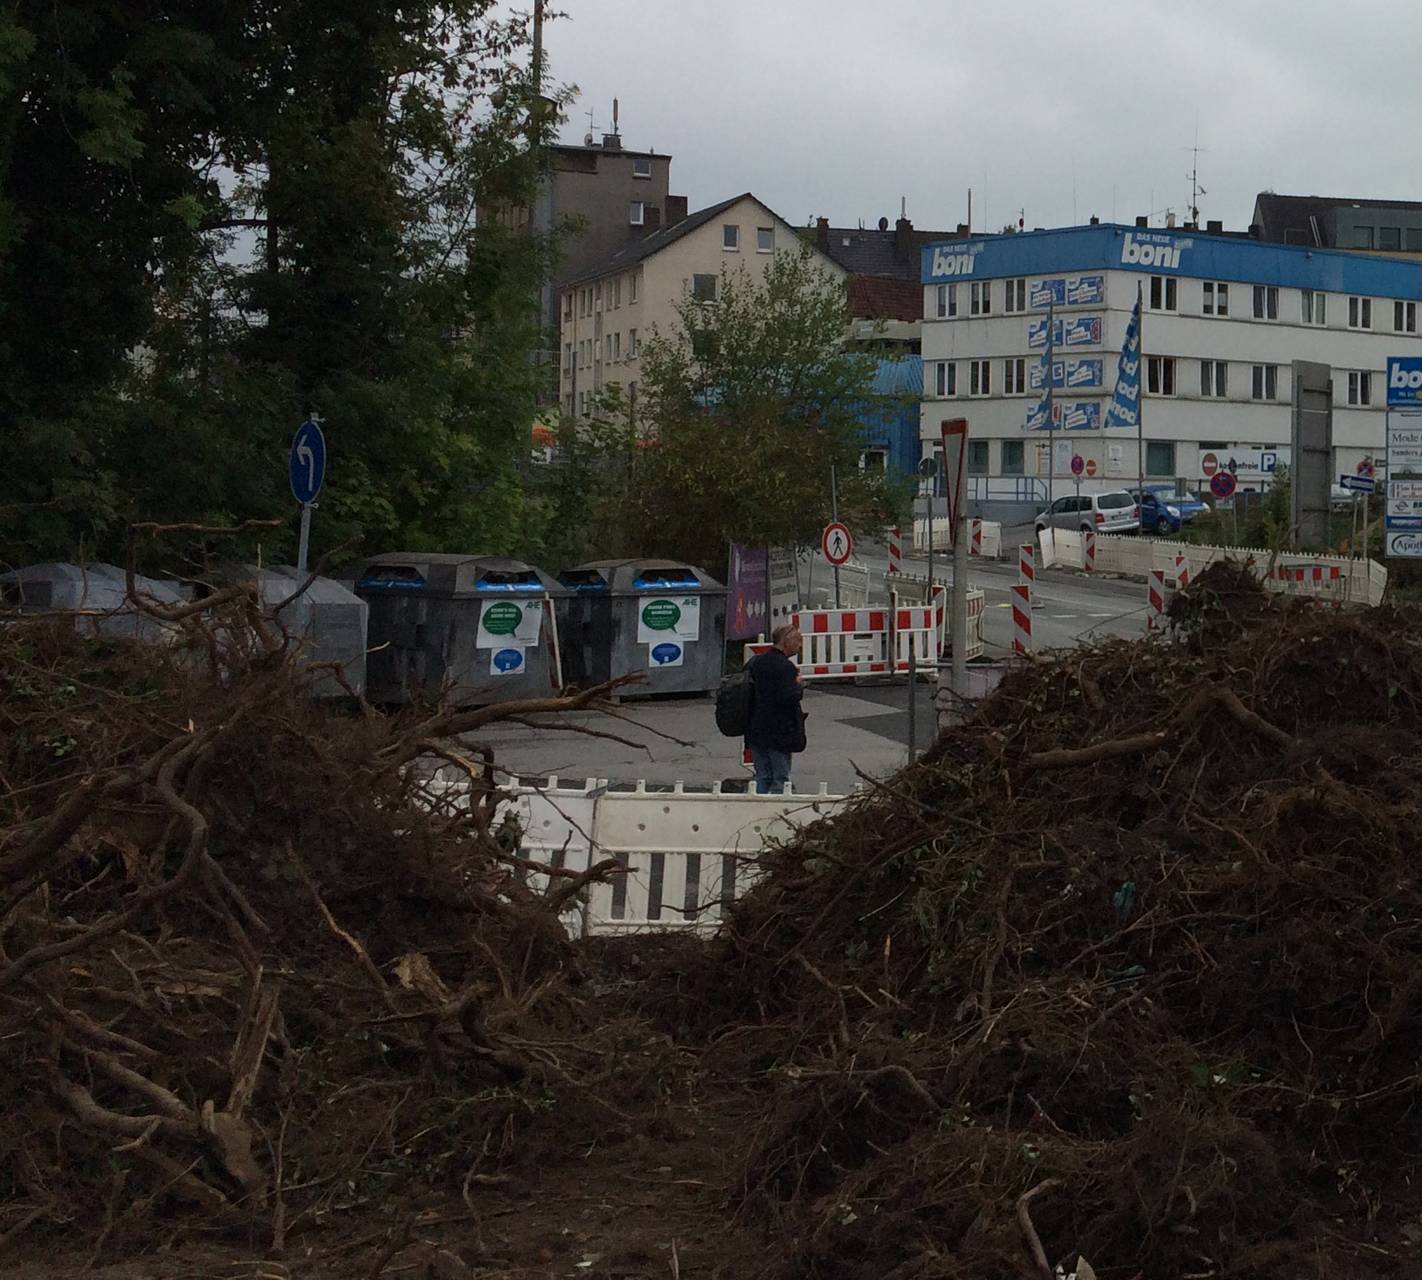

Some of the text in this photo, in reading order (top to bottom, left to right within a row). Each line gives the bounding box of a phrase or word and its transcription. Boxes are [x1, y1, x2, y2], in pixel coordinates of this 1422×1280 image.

[932, 248, 975, 276] boni
[1121, 232, 1181, 268] boni
[1392, 433, 1418, 443] Mode
